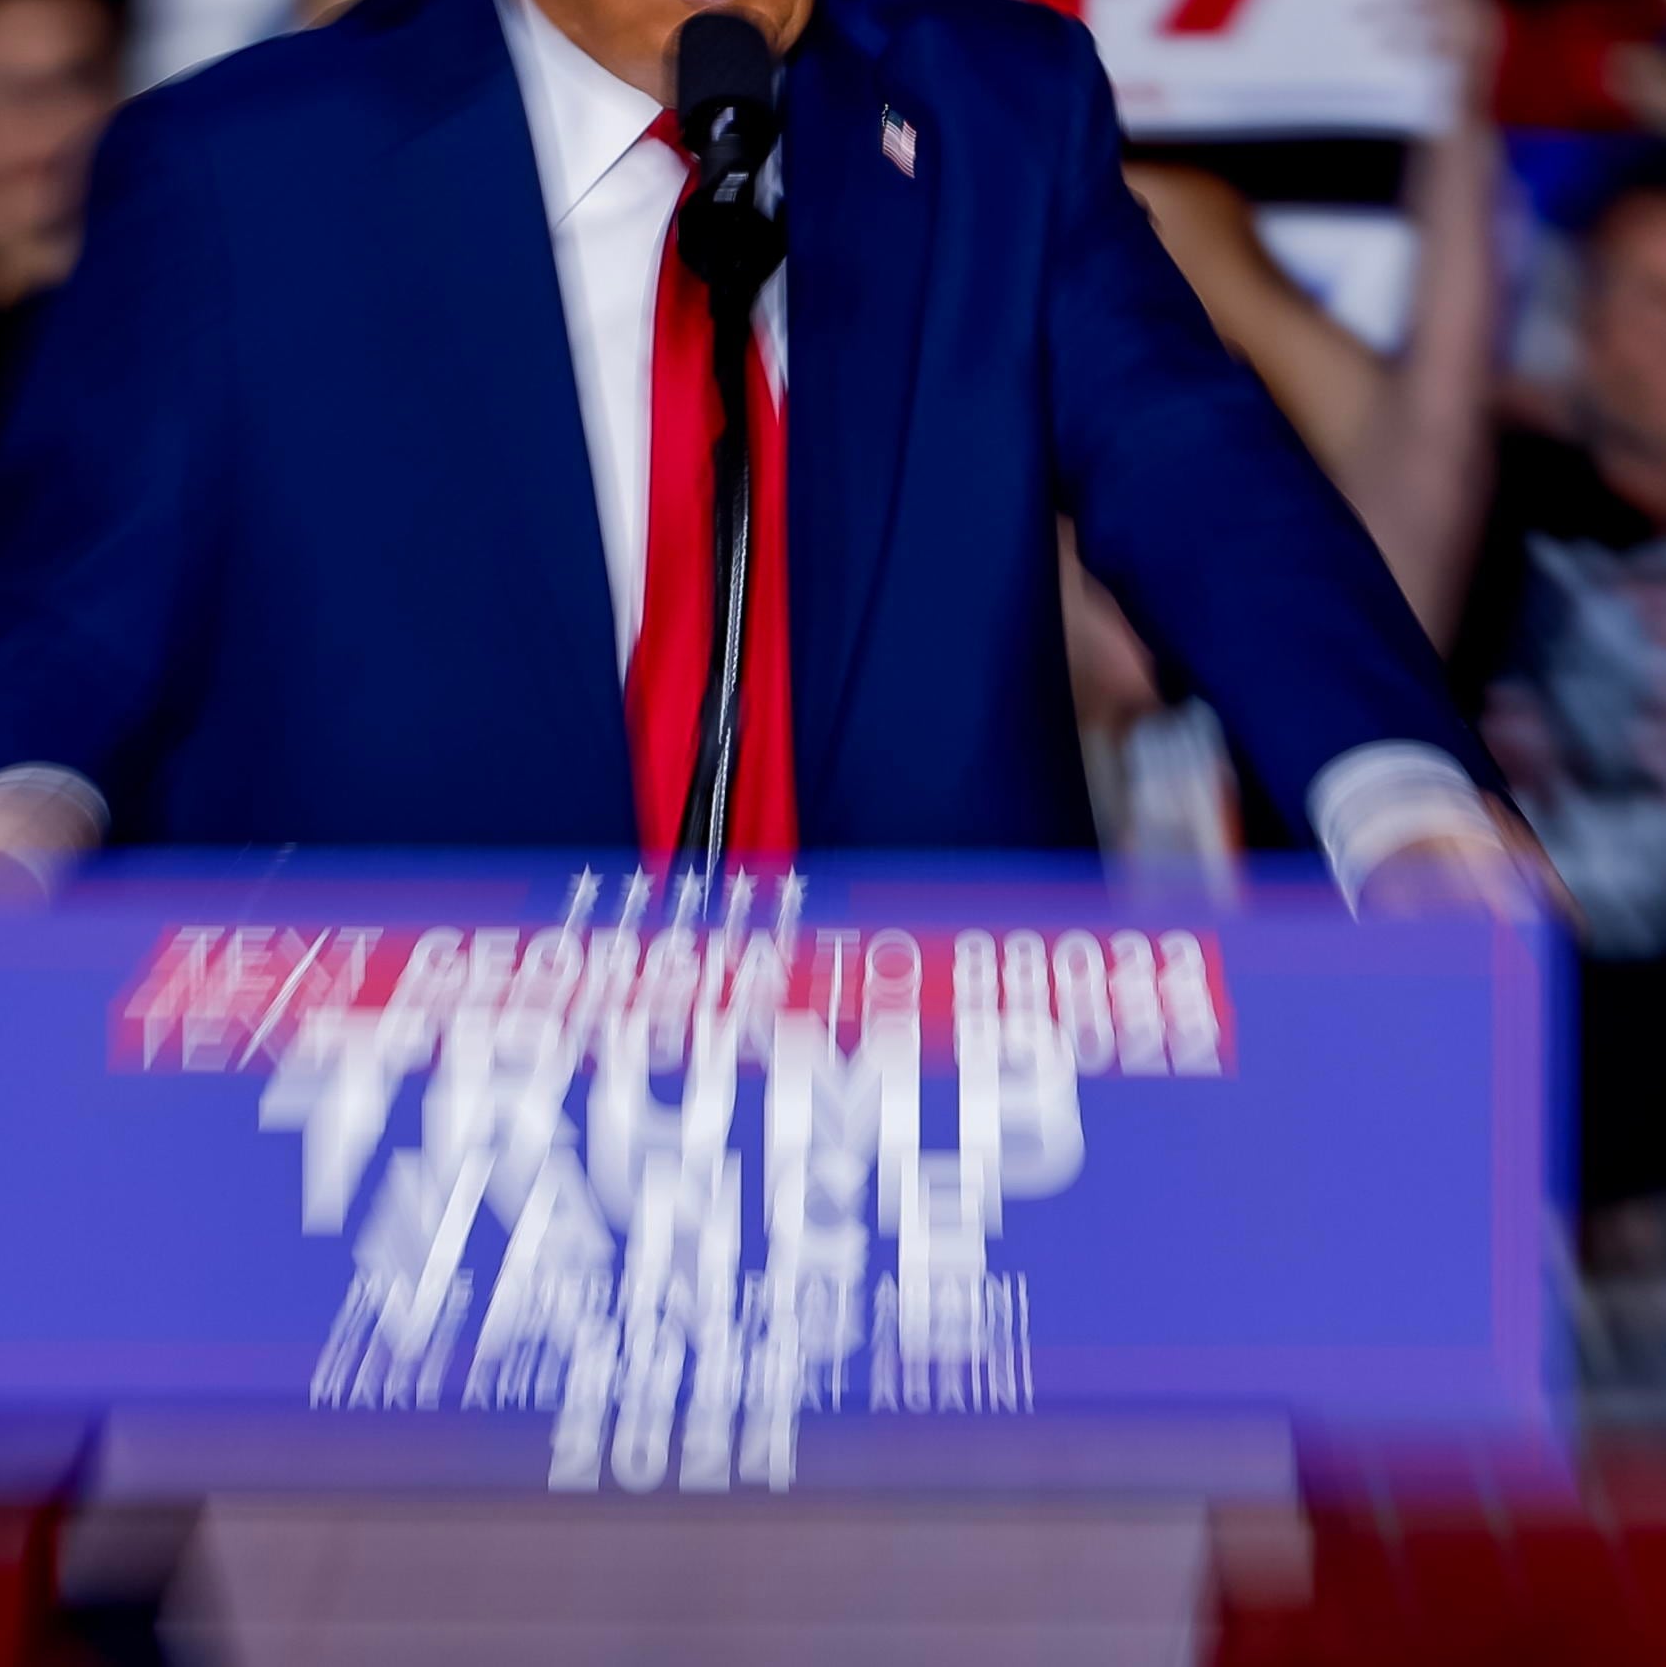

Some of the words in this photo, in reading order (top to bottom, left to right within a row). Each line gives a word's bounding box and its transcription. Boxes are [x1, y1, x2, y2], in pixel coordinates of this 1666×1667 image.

[123, 924, 383, 1072] TEXT
[259, 1002, 1086, 1238] TRUMP
[546, 1314, 798, 1496] 2024
